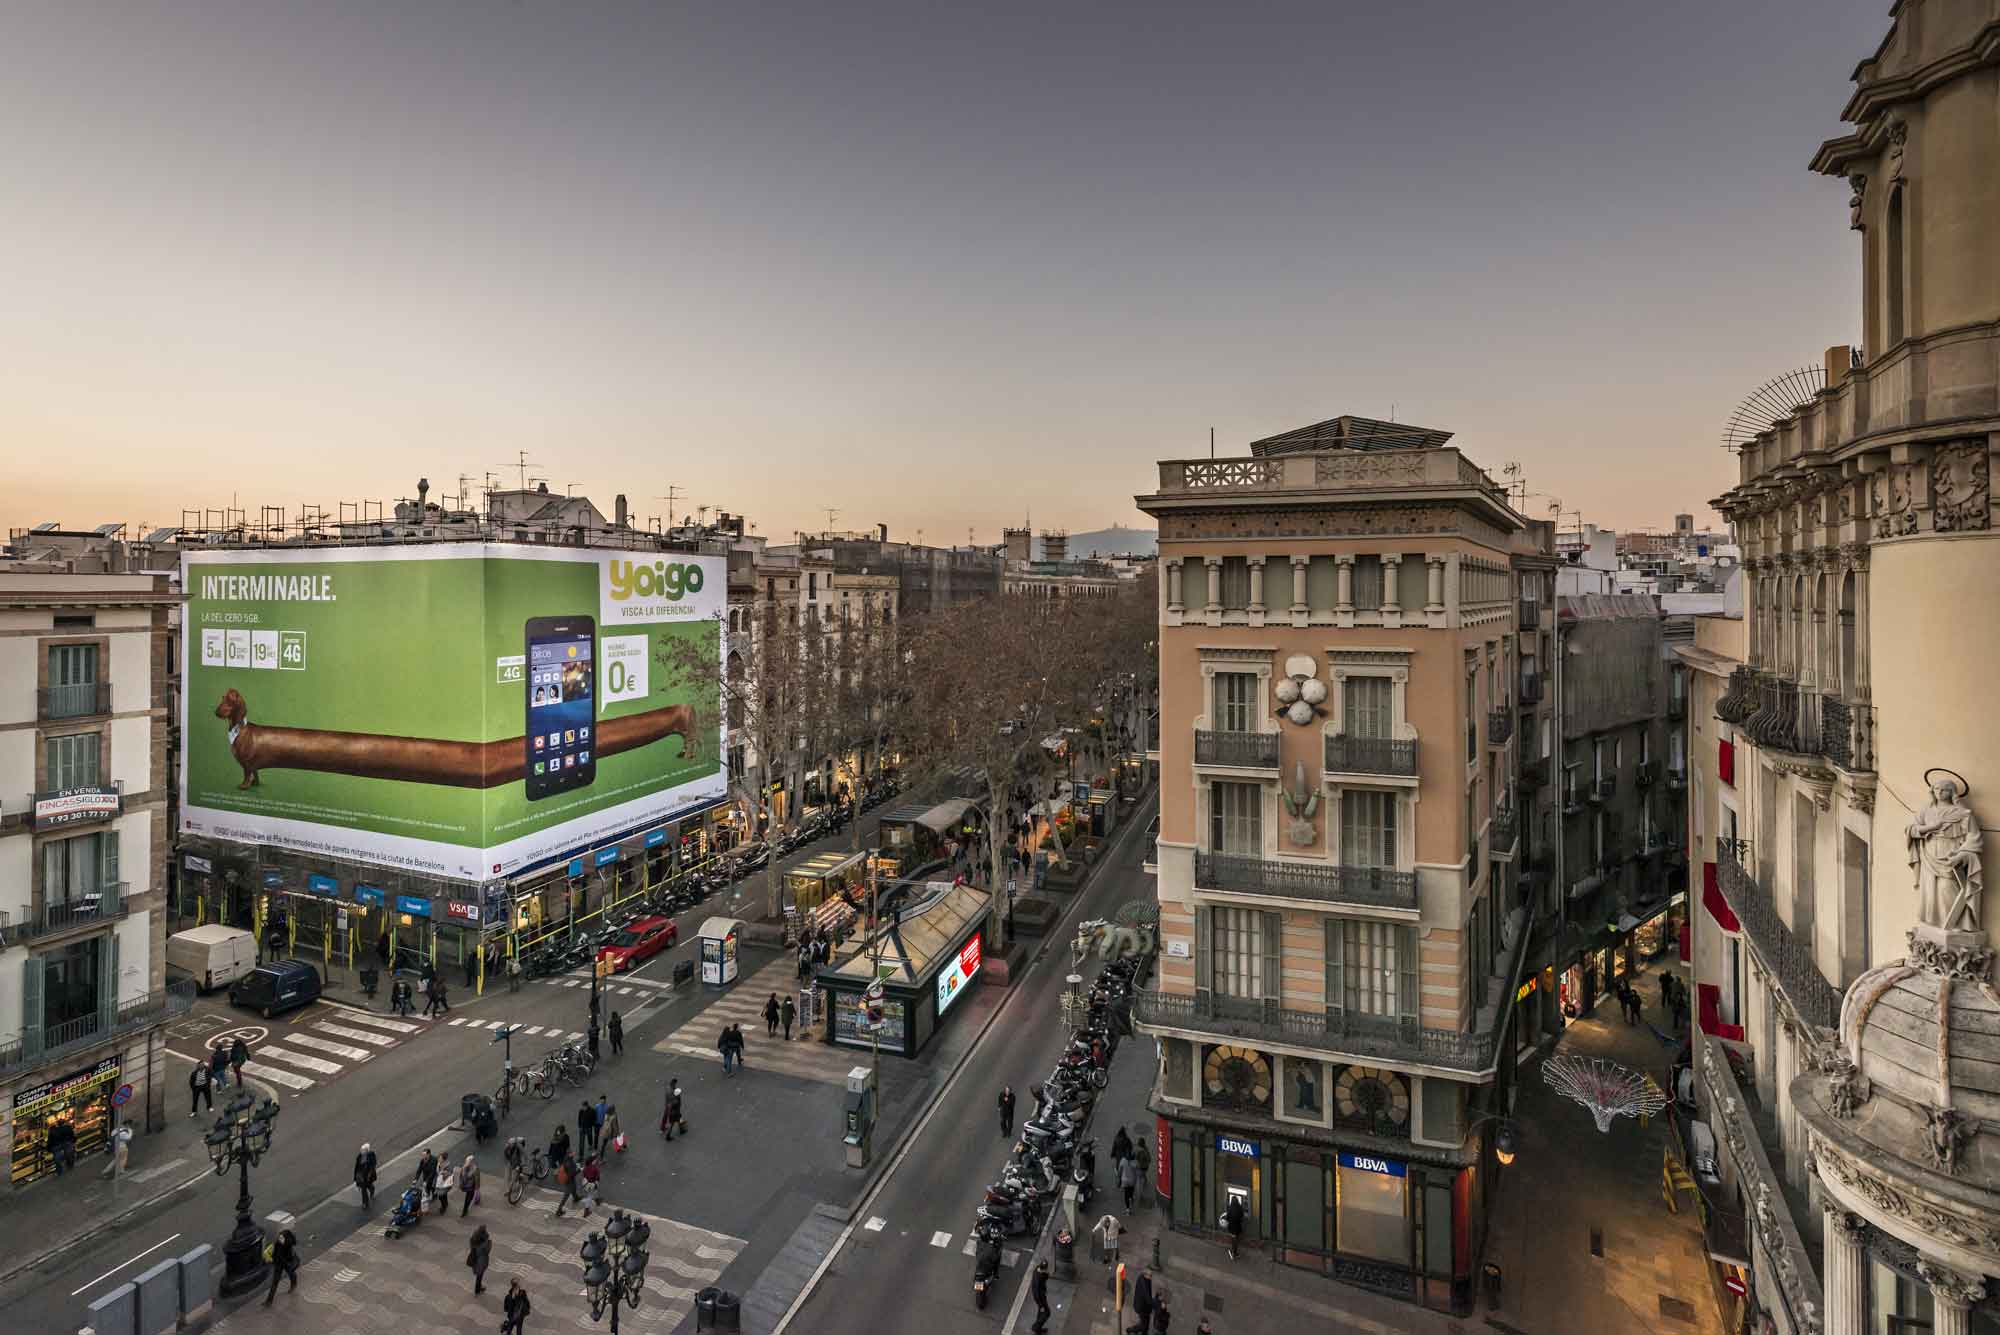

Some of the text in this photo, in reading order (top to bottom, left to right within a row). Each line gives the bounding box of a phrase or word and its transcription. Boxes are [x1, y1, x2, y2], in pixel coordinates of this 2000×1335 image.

[202, 575, 336, 601] INTERMINABLE.
[621, 606, 643, 617] VISCA
[645, 606, 654, 616] LA
[253, 643, 267, 661] 19
[284, 643, 302, 662] 4G
[503, 665, 521, 680] 4G
[59, 787, 101, 797] EN VENDA
[70, 812, 86, 821] 301
[405, 856, 413, 866] de
[414, 858, 445, 871] Barcelona
[14, 1099, 48, 1117] COMPRO
[70, 1075, 102, 1093] COMPRO
[103, 1069, 118, 1081] ORO
[17, 1091, 46, 1106] VENDA
[1221, 1139, 1254, 1156] BBVA
[1354, 1156, 1389, 1174] BBVA
